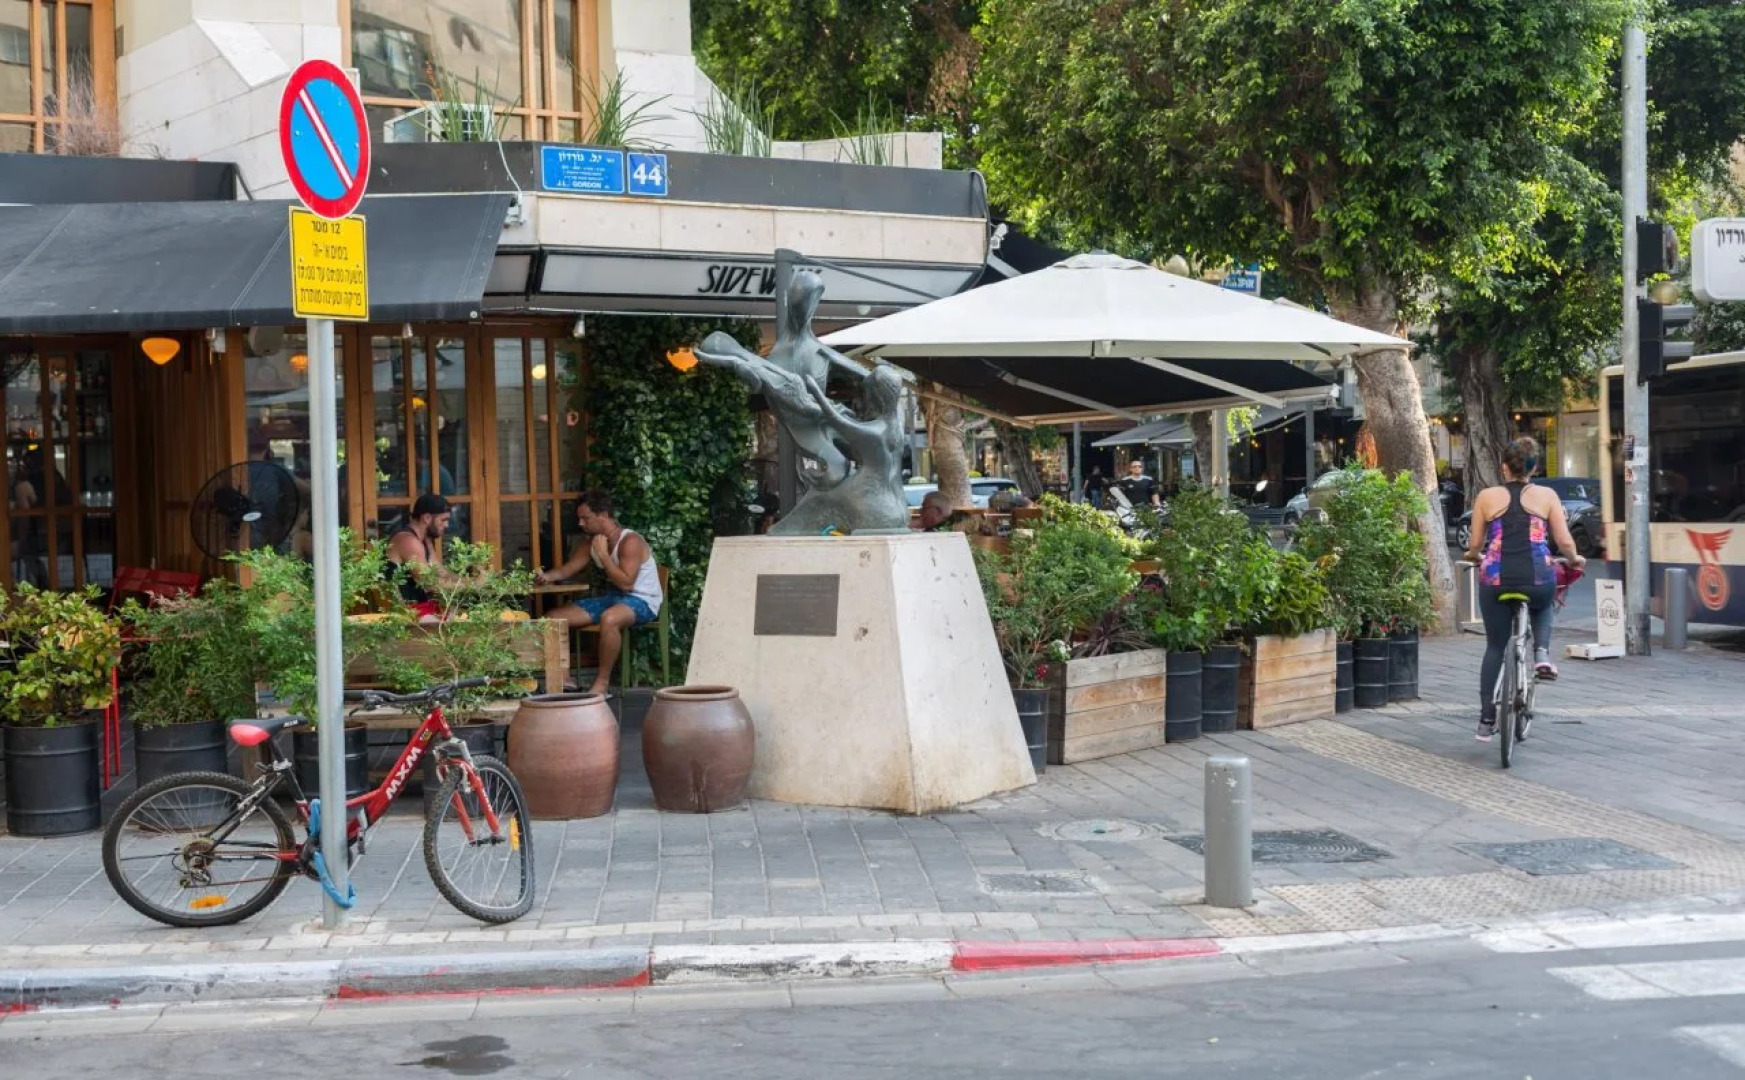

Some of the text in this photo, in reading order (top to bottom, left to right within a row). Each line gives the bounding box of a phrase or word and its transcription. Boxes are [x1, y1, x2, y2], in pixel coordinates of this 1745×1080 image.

[559, 151, 584, 163] גורדון
[632, 163, 663, 186] 44
[572, 180, 602, 189] GORDON
[311, 220, 341, 234] 12 מטר
[698, 265, 822, 295] SIDEW
[386, 746, 422, 801] MXM
